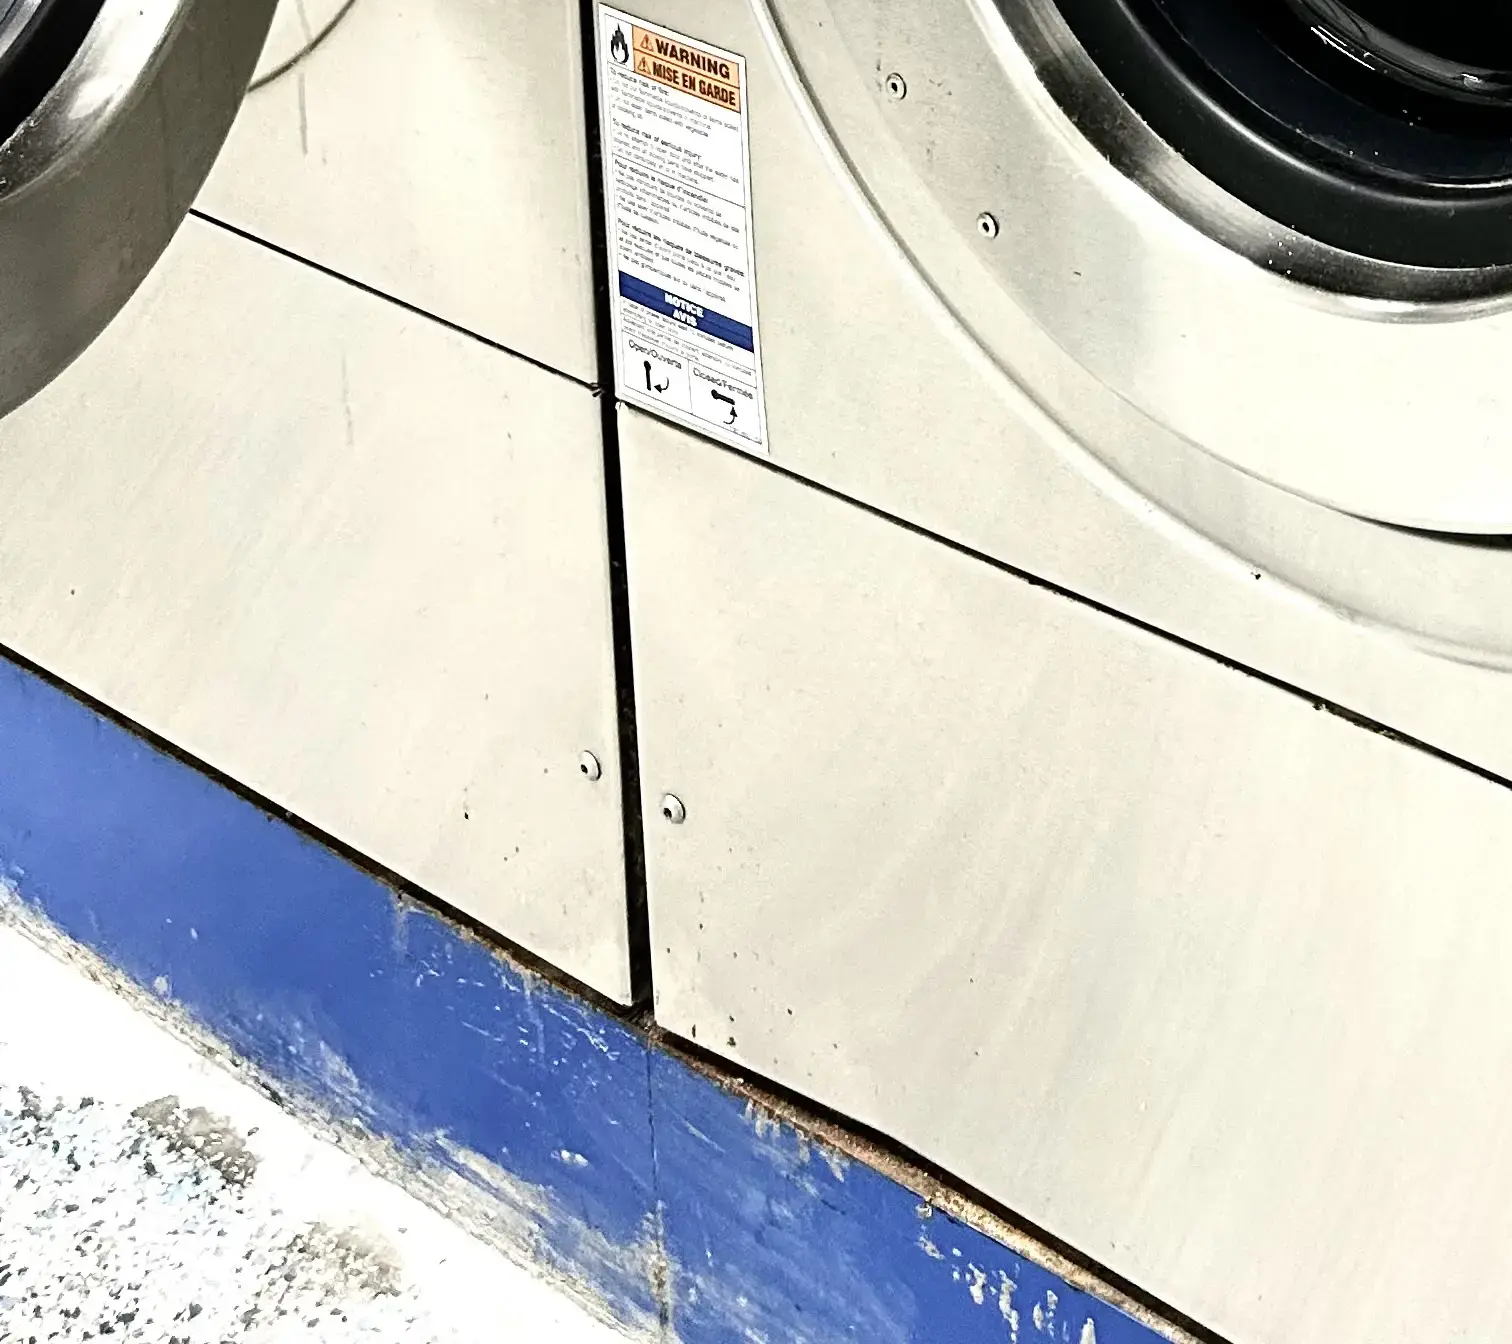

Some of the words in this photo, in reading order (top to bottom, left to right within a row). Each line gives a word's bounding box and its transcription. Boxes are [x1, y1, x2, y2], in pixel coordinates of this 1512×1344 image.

[655, 38, 729, 79] WARNING
[652, 61, 679, 85] MISE
[681, 72, 696, 91] EN
[698, 79, 735, 106] GARDE
